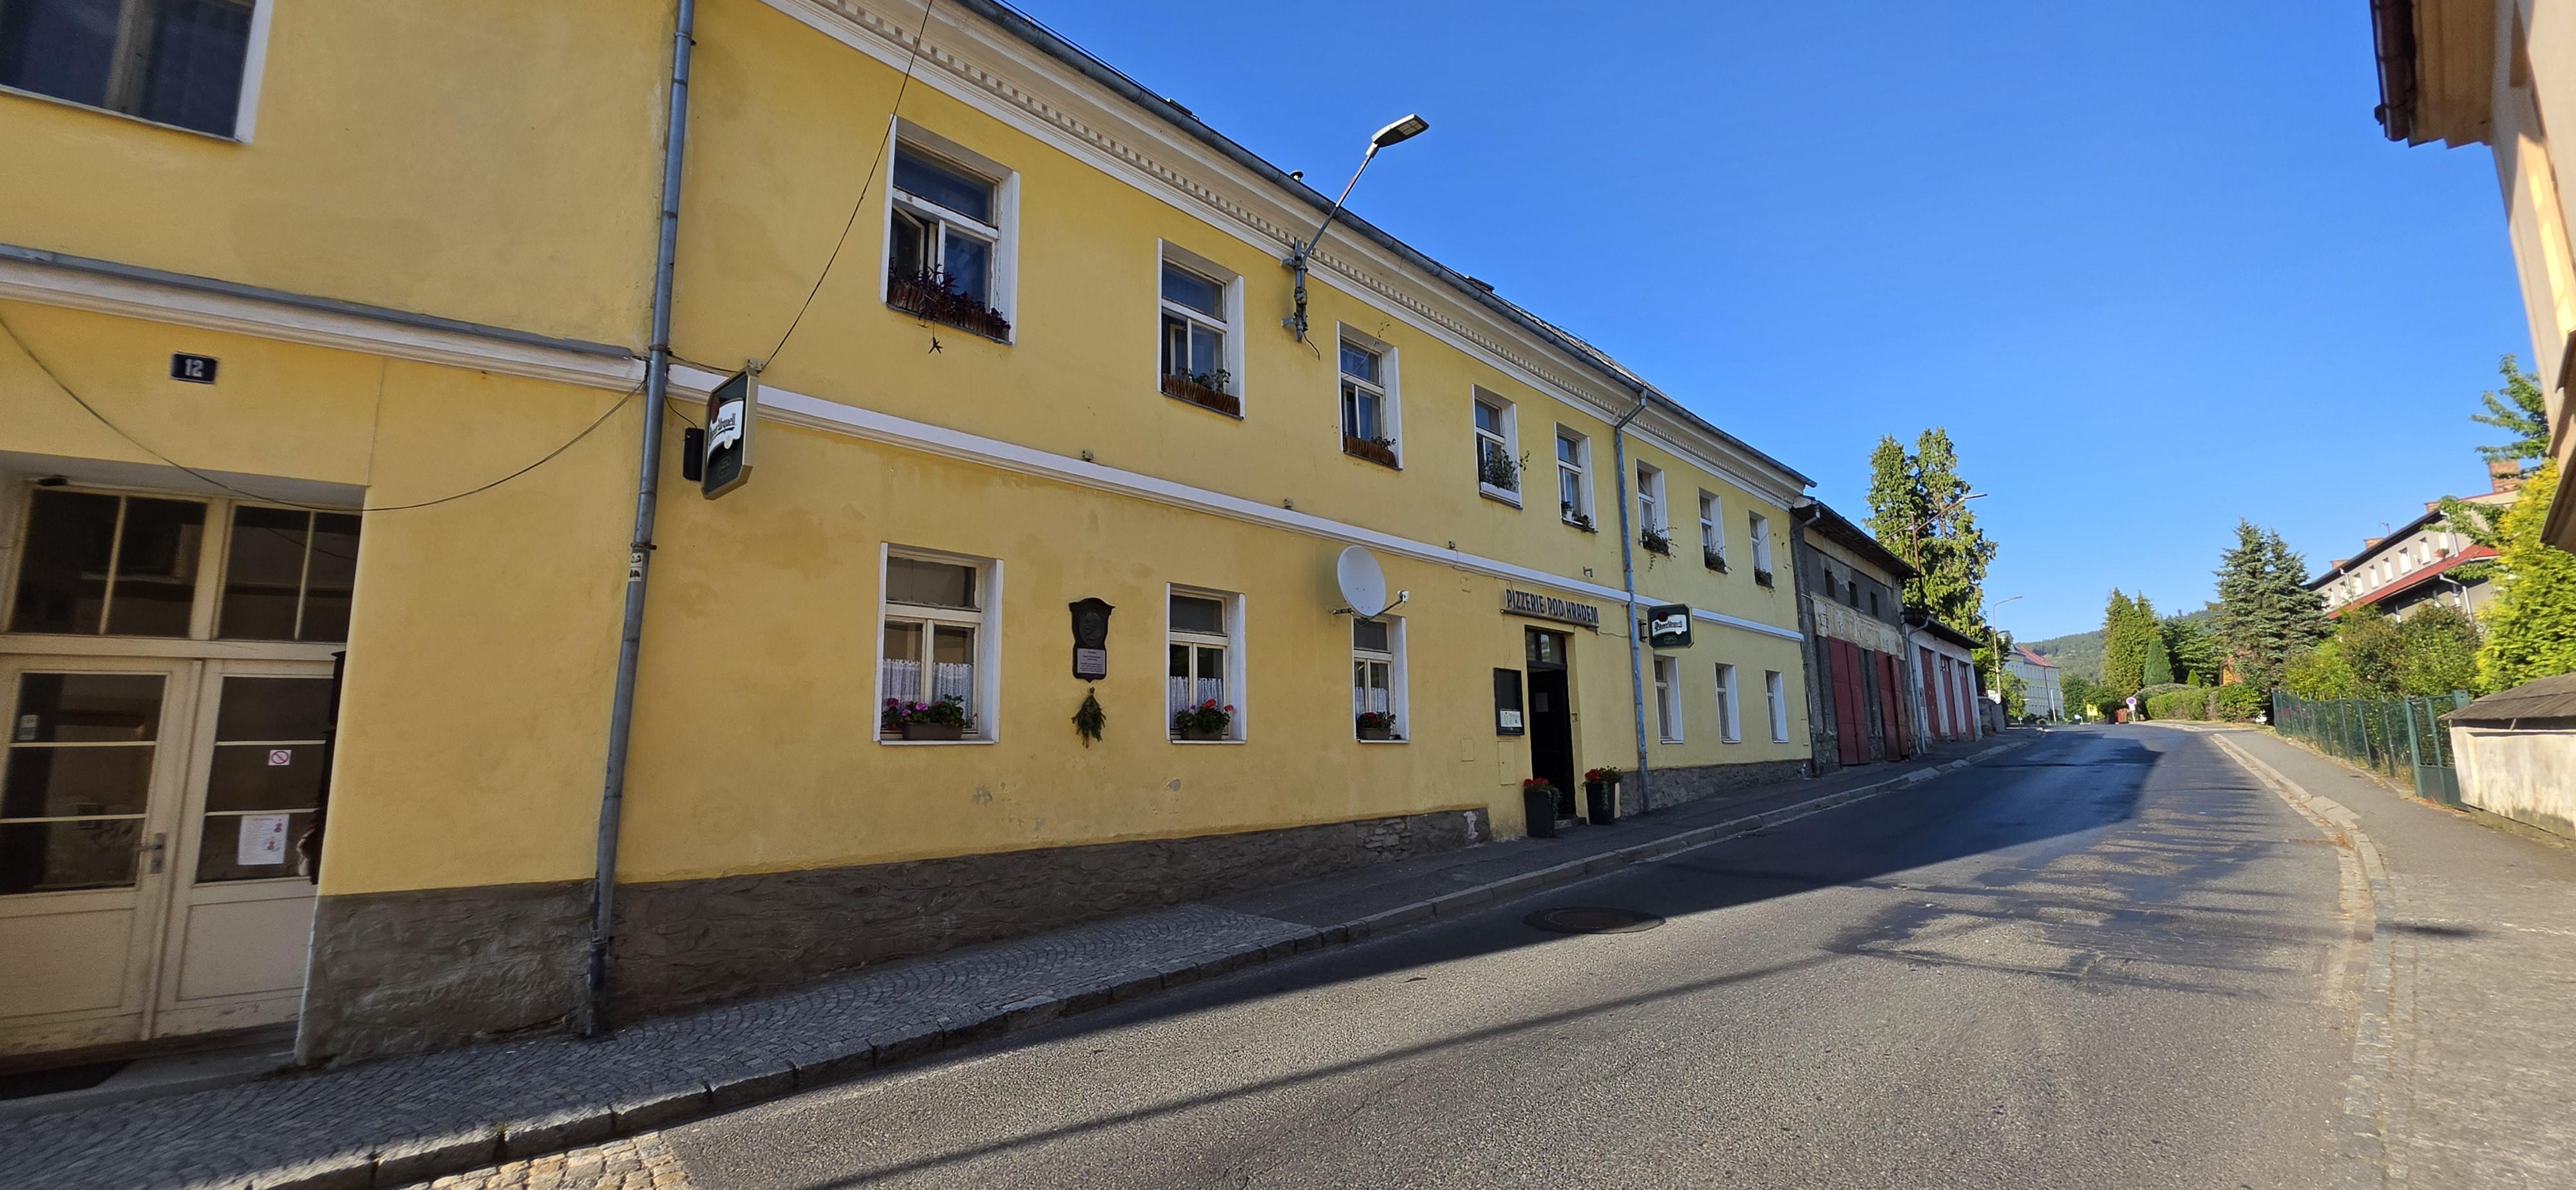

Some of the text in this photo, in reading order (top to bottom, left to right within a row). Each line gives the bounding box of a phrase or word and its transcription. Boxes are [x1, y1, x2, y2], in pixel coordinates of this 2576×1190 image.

[185, 359, 204, 377] 12
[1506, 589, 1599, 623] PIZZERIE POD HRADEM
